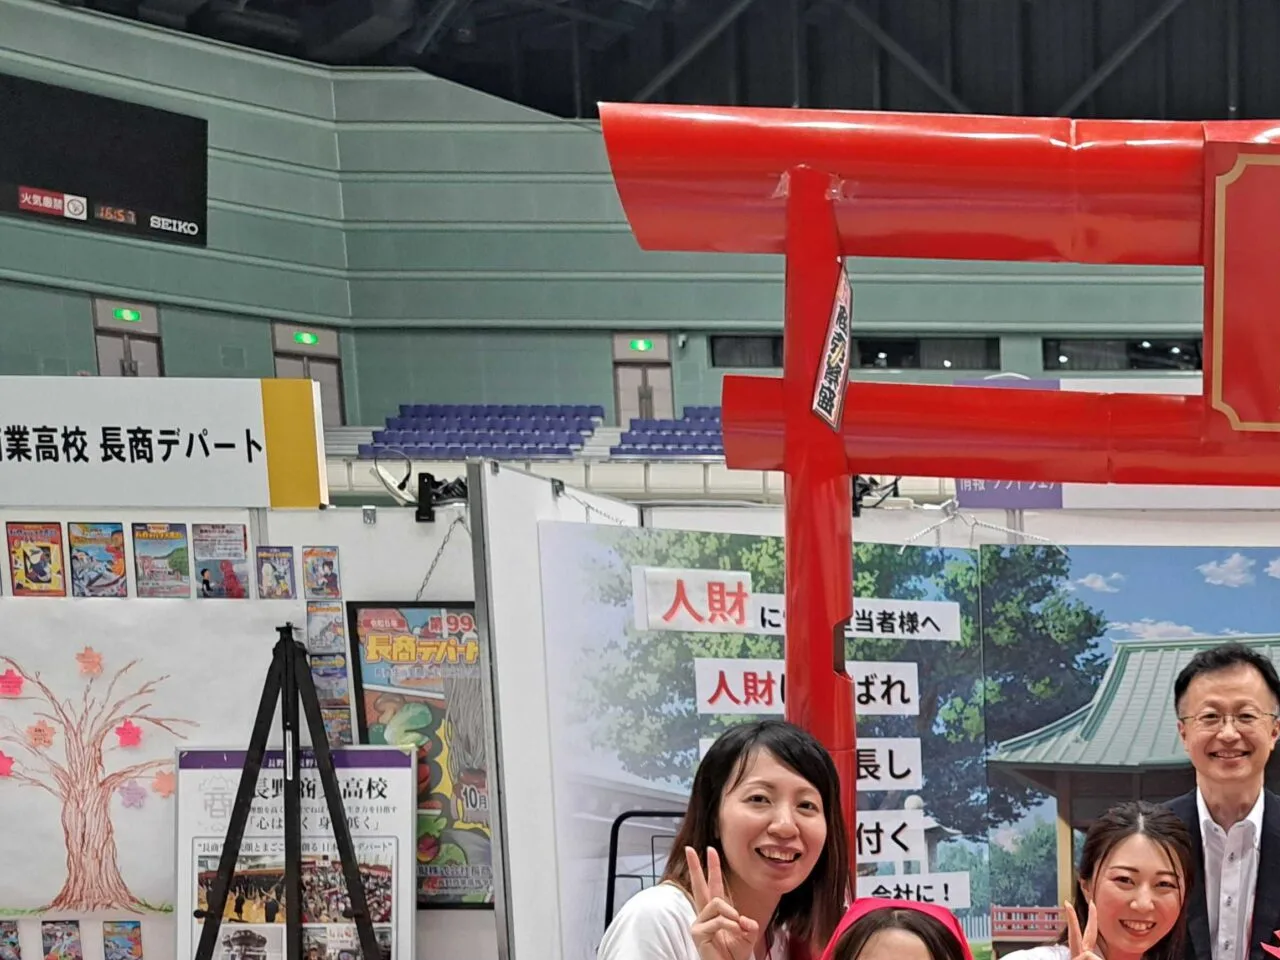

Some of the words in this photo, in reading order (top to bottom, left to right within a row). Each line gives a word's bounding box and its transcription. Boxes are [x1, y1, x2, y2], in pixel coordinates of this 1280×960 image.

[150, 215, 199, 236] SEIKO
[0, 425, 90, 463] 業高校
[100, 426, 263, 463] 長商デパート
[366, 635, 478, 663] 長商デパート
